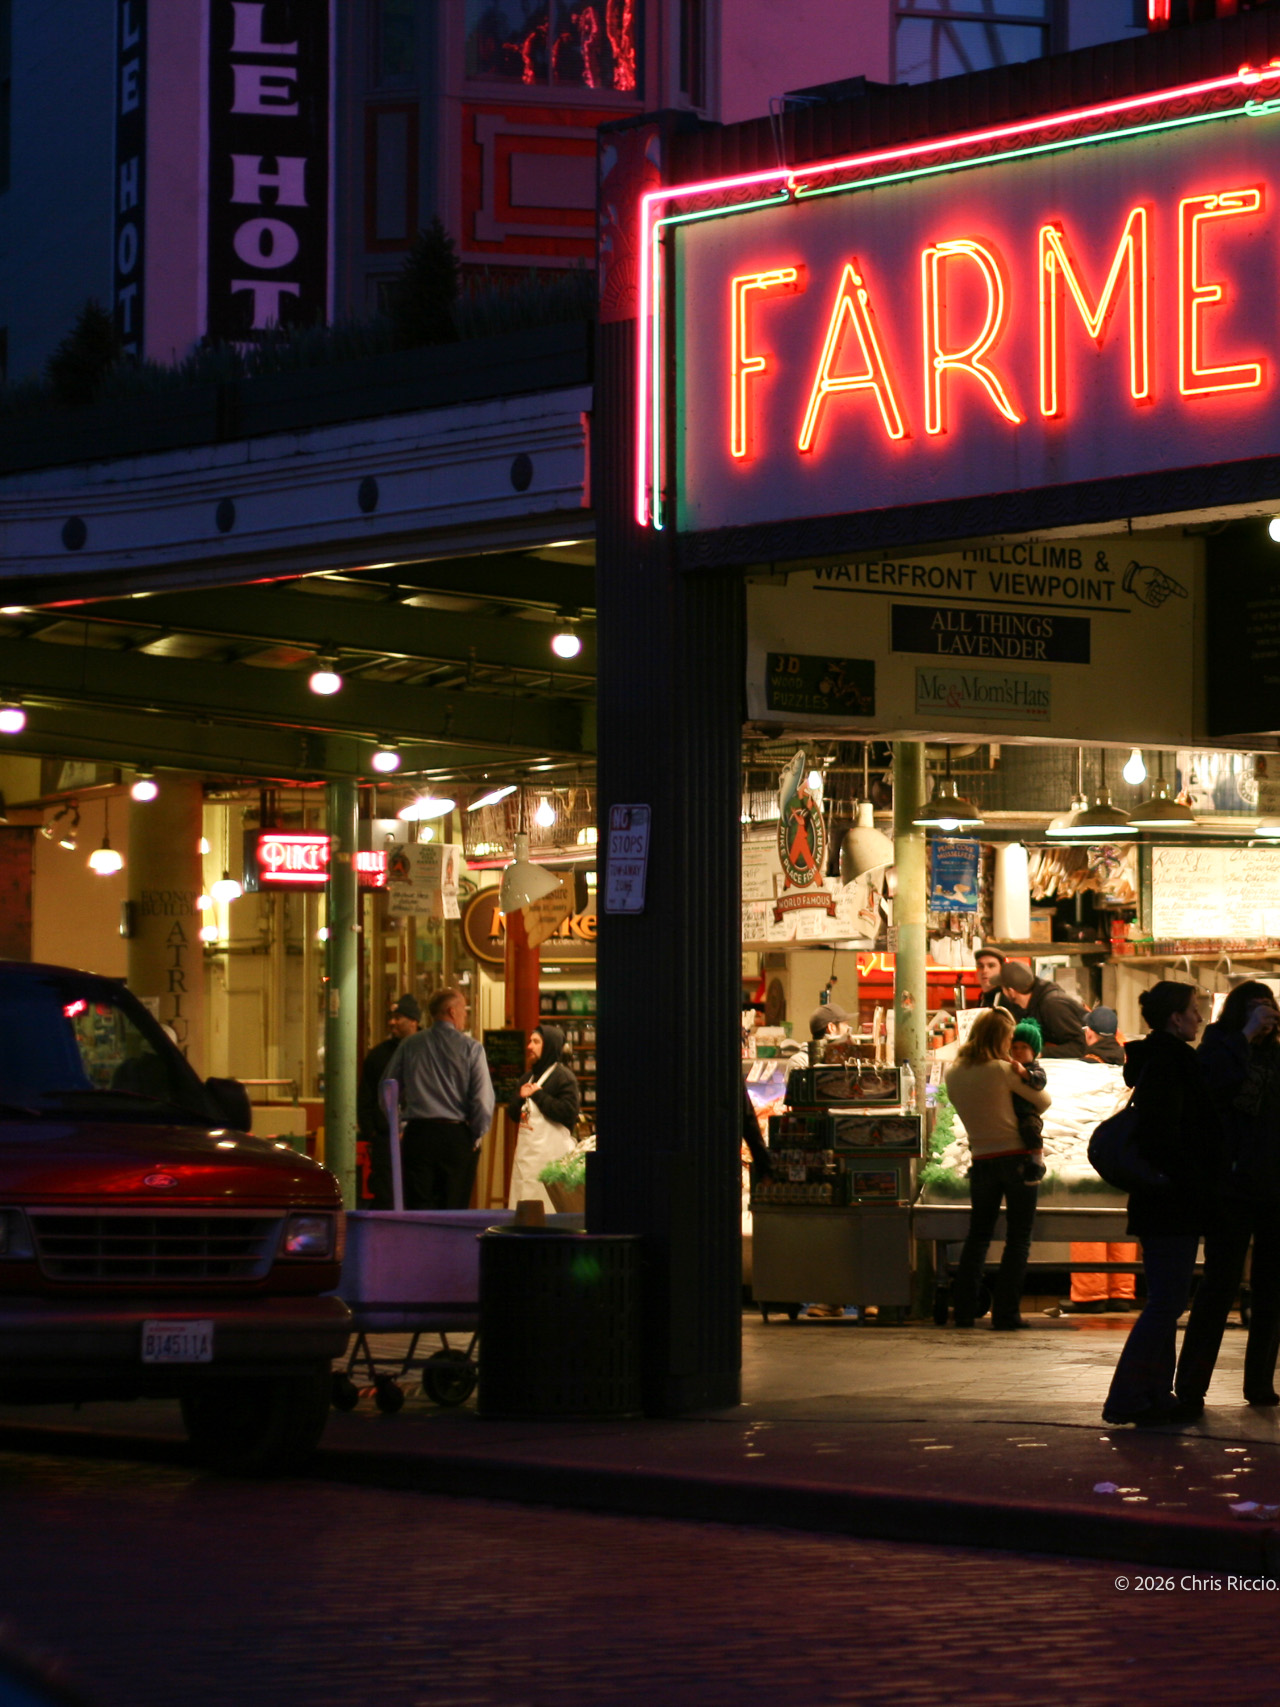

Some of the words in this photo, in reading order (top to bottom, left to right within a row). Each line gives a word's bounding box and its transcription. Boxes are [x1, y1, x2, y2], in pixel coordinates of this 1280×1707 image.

[962, 544, 1083, 570] HILLCLIMB
[1094, 550, 1110, 573] &
[814, 561, 977, 591] WATERFRONT
[988, 570, 1116, 603] VIEWPOINT
[930, 610, 975, 634] ALL
[975, 612, 1054, 639] THINGS
[936, 632, 1049, 661] LAVENDER
[773, 690, 830, 711] PUZZLES
[612, 807, 629, 831] NO
[611, 835, 644, 854] STOPS
[783, 858, 802, 884] PLACE
[803, 864, 817, 884] FISH
[812, 811, 823, 864] MARKET
[610, 864, 642, 877] TOW-AWAY
[615, 879, 634, 892] ZONE
[777, 896, 802, 909] WORLD
[802, 895, 831, 907] FAMOUS
